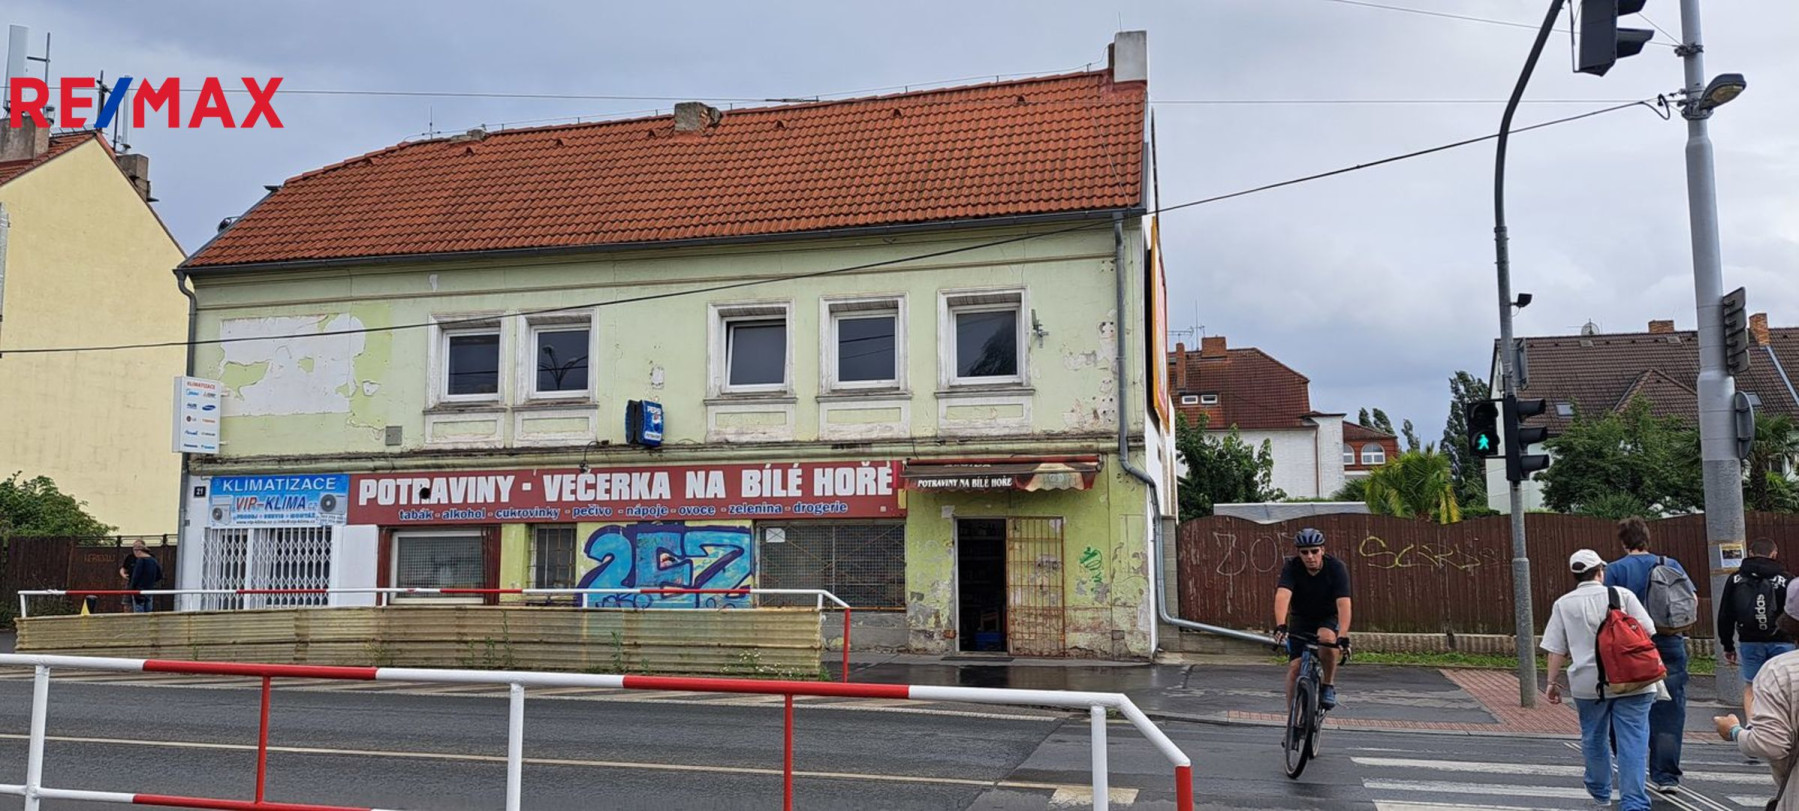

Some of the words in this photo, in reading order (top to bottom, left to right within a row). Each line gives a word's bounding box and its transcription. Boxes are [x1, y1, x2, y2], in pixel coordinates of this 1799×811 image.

[223, 477, 336, 492] KLIMATIZACE
[358, 475, 516, 506] POTRAVINY
[685, 470, 726, 499] NA
[741, 463, 803, 498] BÍLÉ
[917, 478, 958, 488] POTRAVINY
[959, 479, 970, 487] NA
[971, 476, 989, 488] BÍLÉ
[991, 475, 1013, 488] HOŘE
[399, 507, 433, 520] tabák
[442, 507, 487, 519] alkohol
[494, 505, 560, 520] cukrovinky
[571, 503, 613, 519] pečivo
[625, 503, 669, 518] nápoje
[677, 505, 716, 516] ovoce
[728, 501, 783, 515] zelenina
[792, 500, 848, 514] drogerie
[1755, 594, 1768, 631] adidas
